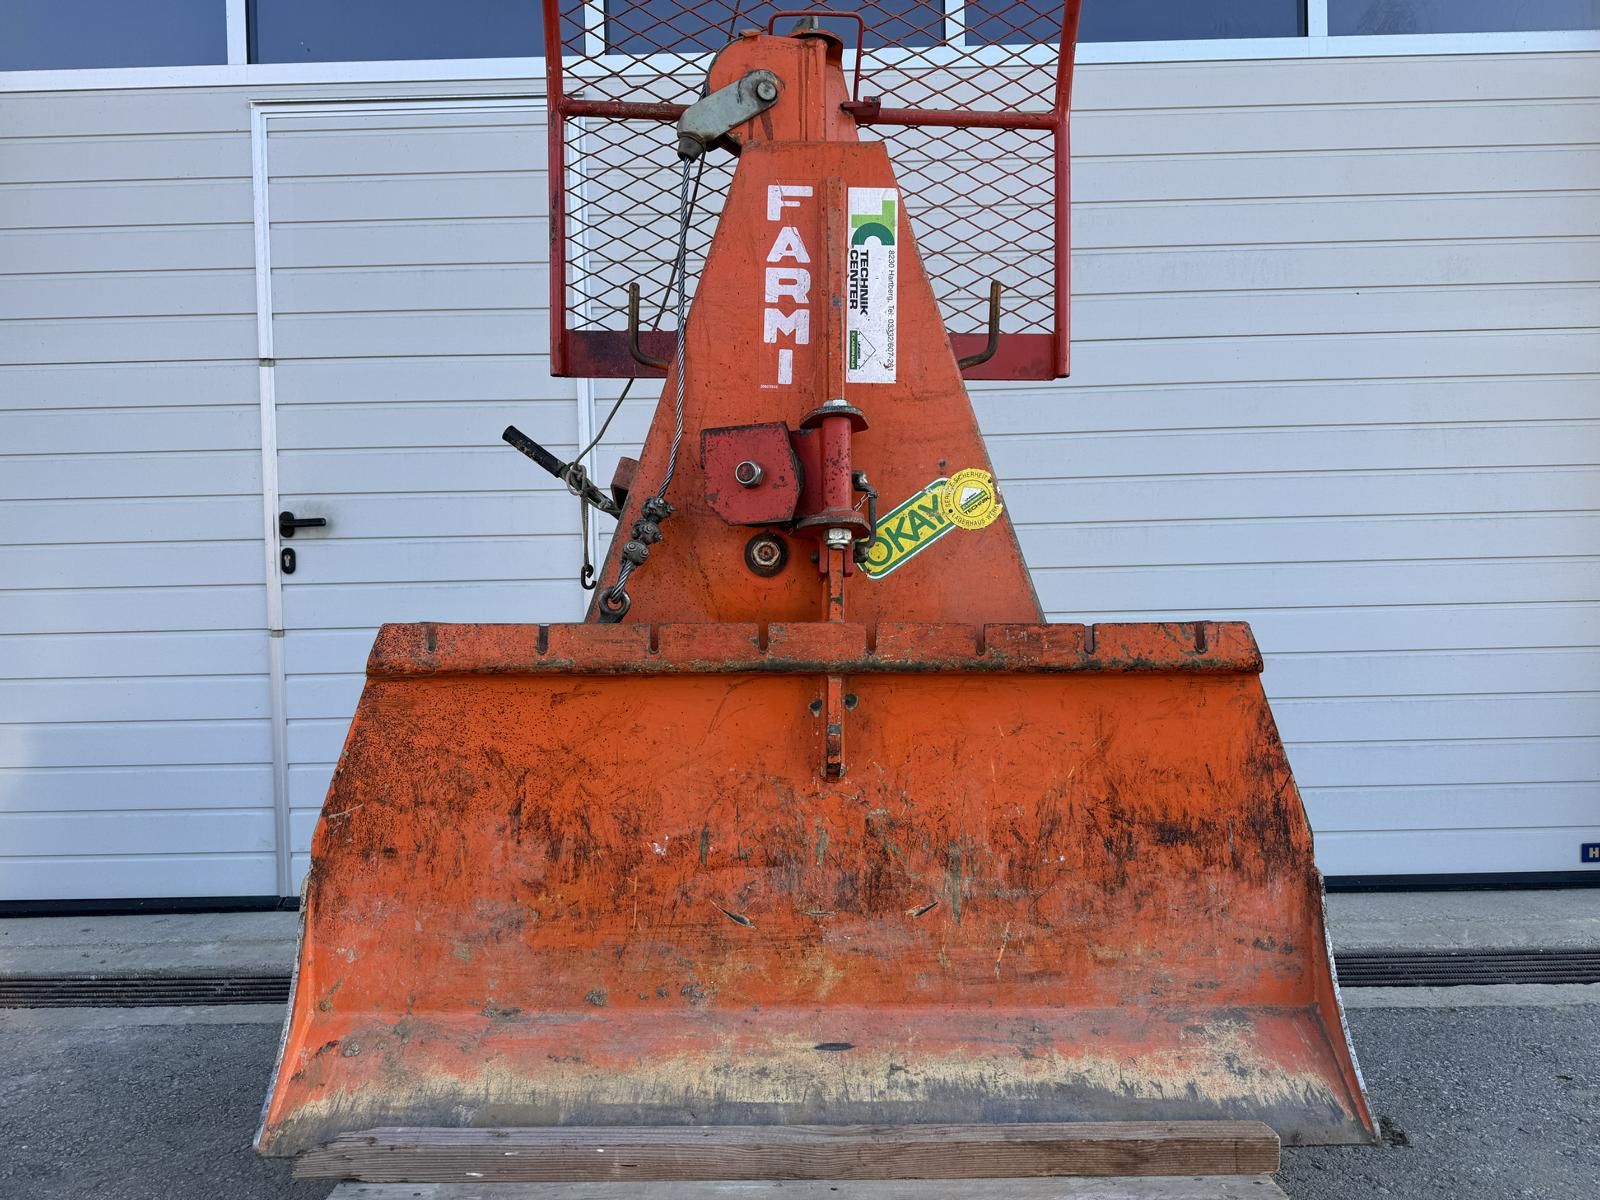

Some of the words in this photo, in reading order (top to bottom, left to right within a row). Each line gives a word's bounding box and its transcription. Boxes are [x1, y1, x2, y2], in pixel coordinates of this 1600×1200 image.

[764, 185, 813, 385] FARMI
[849, 250, 859, 310] CENTER
[860, 250, 869, 315] TECHNIK
[886, 270, 895, 303] Hartberg,
[887, 250, 895, 268] 8230
[864, 494, 945, 566] OKAY
